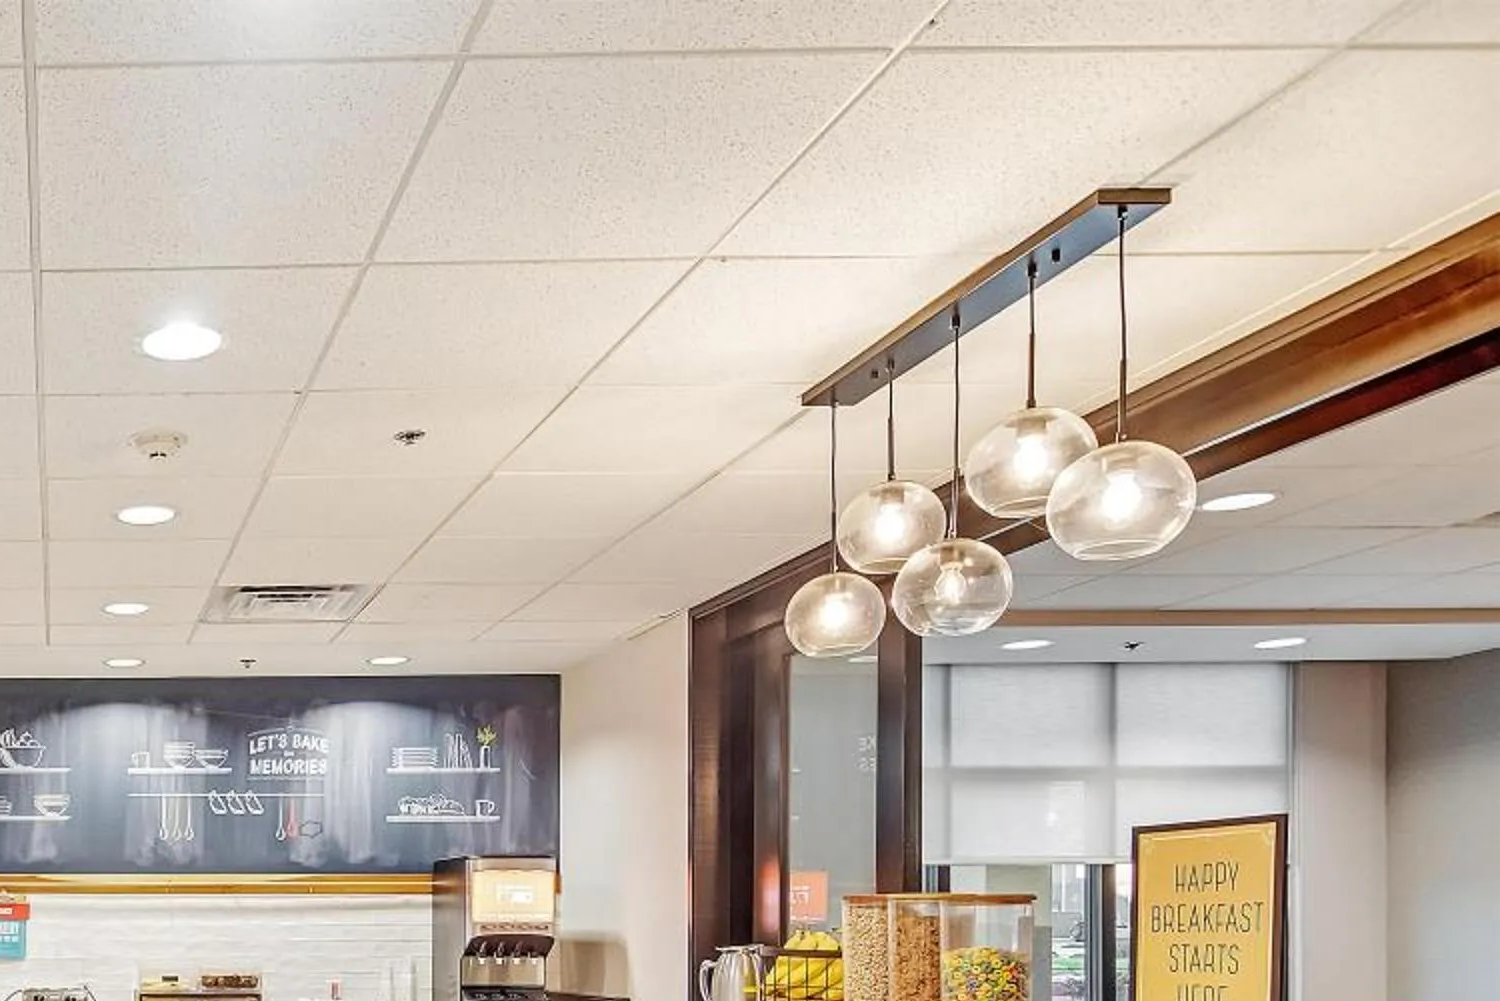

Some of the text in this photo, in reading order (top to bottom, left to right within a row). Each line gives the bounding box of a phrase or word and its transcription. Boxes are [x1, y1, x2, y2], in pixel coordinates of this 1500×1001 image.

[249, 733, 331, 755] LET'S BAKE
[249, 758, 328, 775] MEMORIES
[1174, 861, 1240, 893] HAPPY
[1150, 901, 1265, 934] BREAKFAST
[1168, 943, 1240, 975] STARTS
